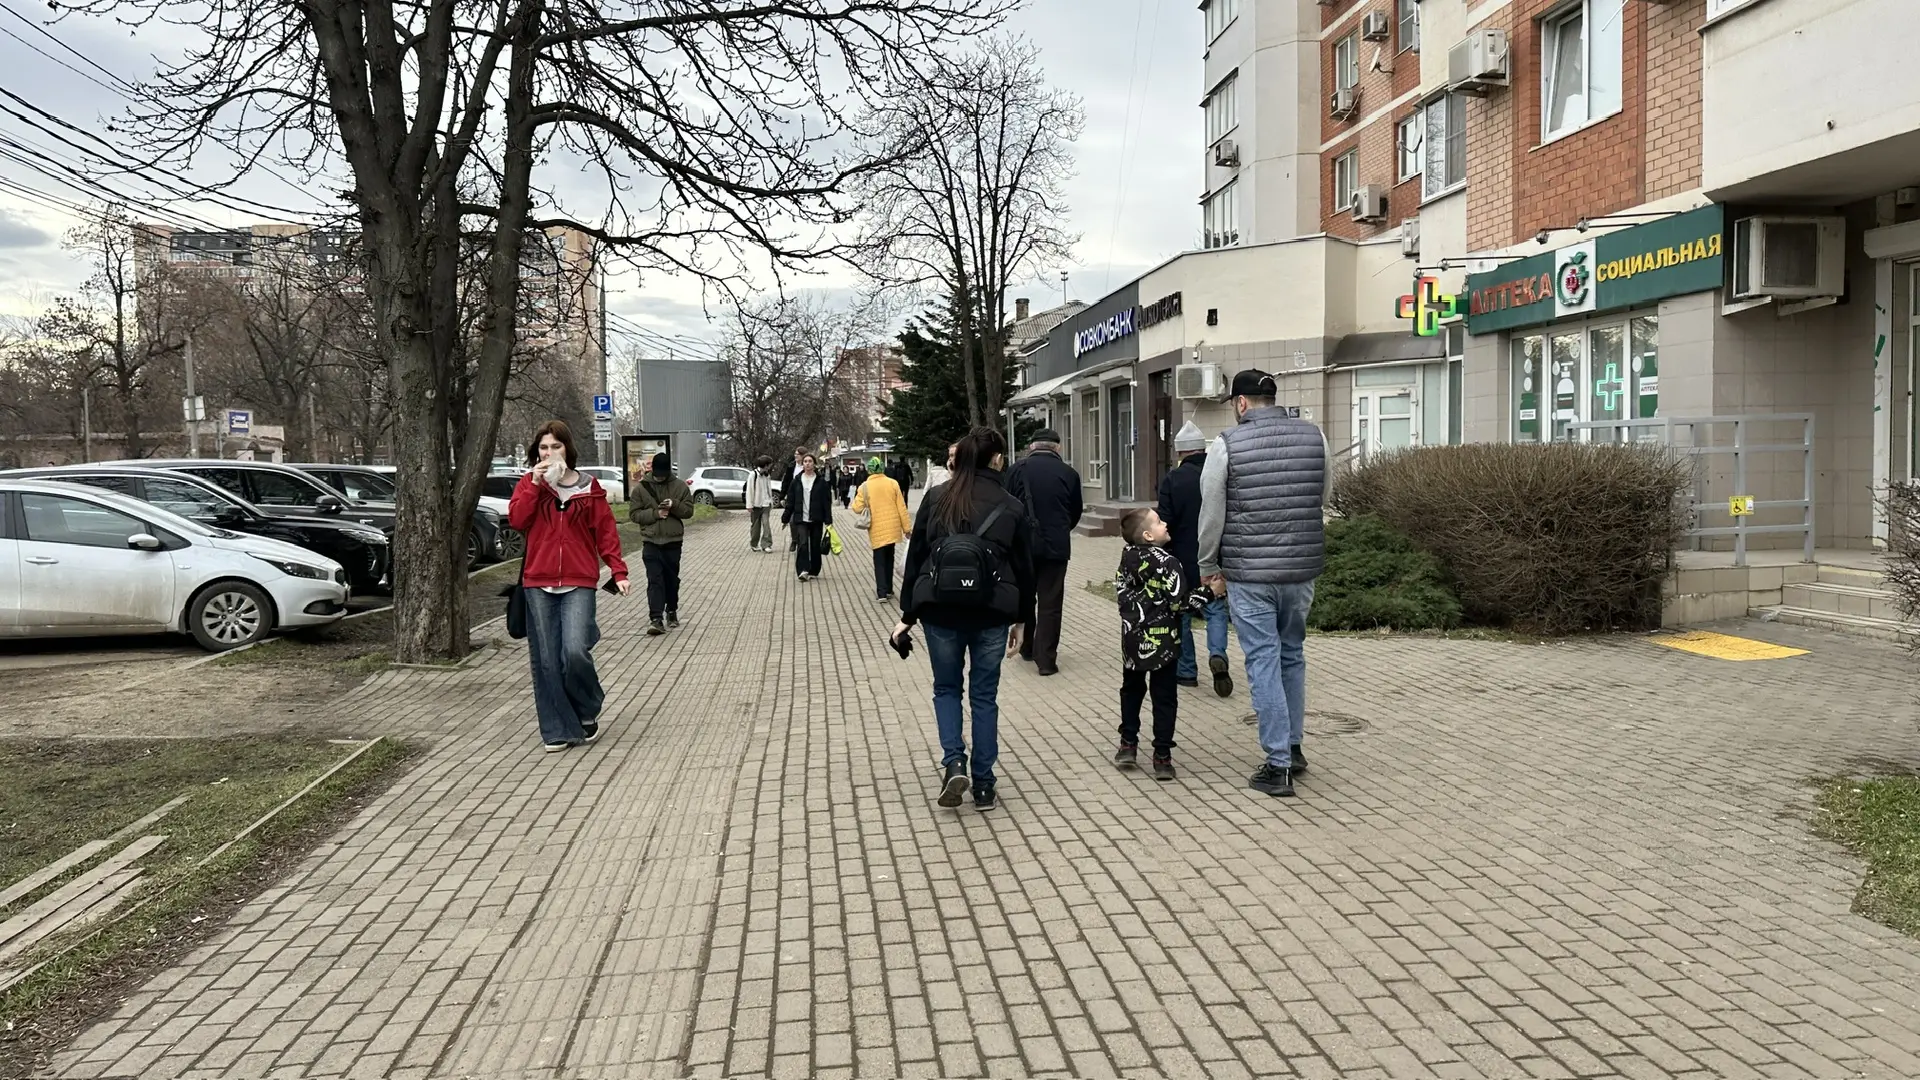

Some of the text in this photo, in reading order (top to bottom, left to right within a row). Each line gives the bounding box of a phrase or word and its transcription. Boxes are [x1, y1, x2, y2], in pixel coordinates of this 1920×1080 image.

[1470, 234, 1721, 316] АПТЕКА СОЦИАЛЬНАЯ
[1079, 307, 1135, 354] СОВКОМБАНК
[598, 397, 608, 410] P
[960, 579, 974, 587] W
[1139, 642, 1158, 651] NIKE
